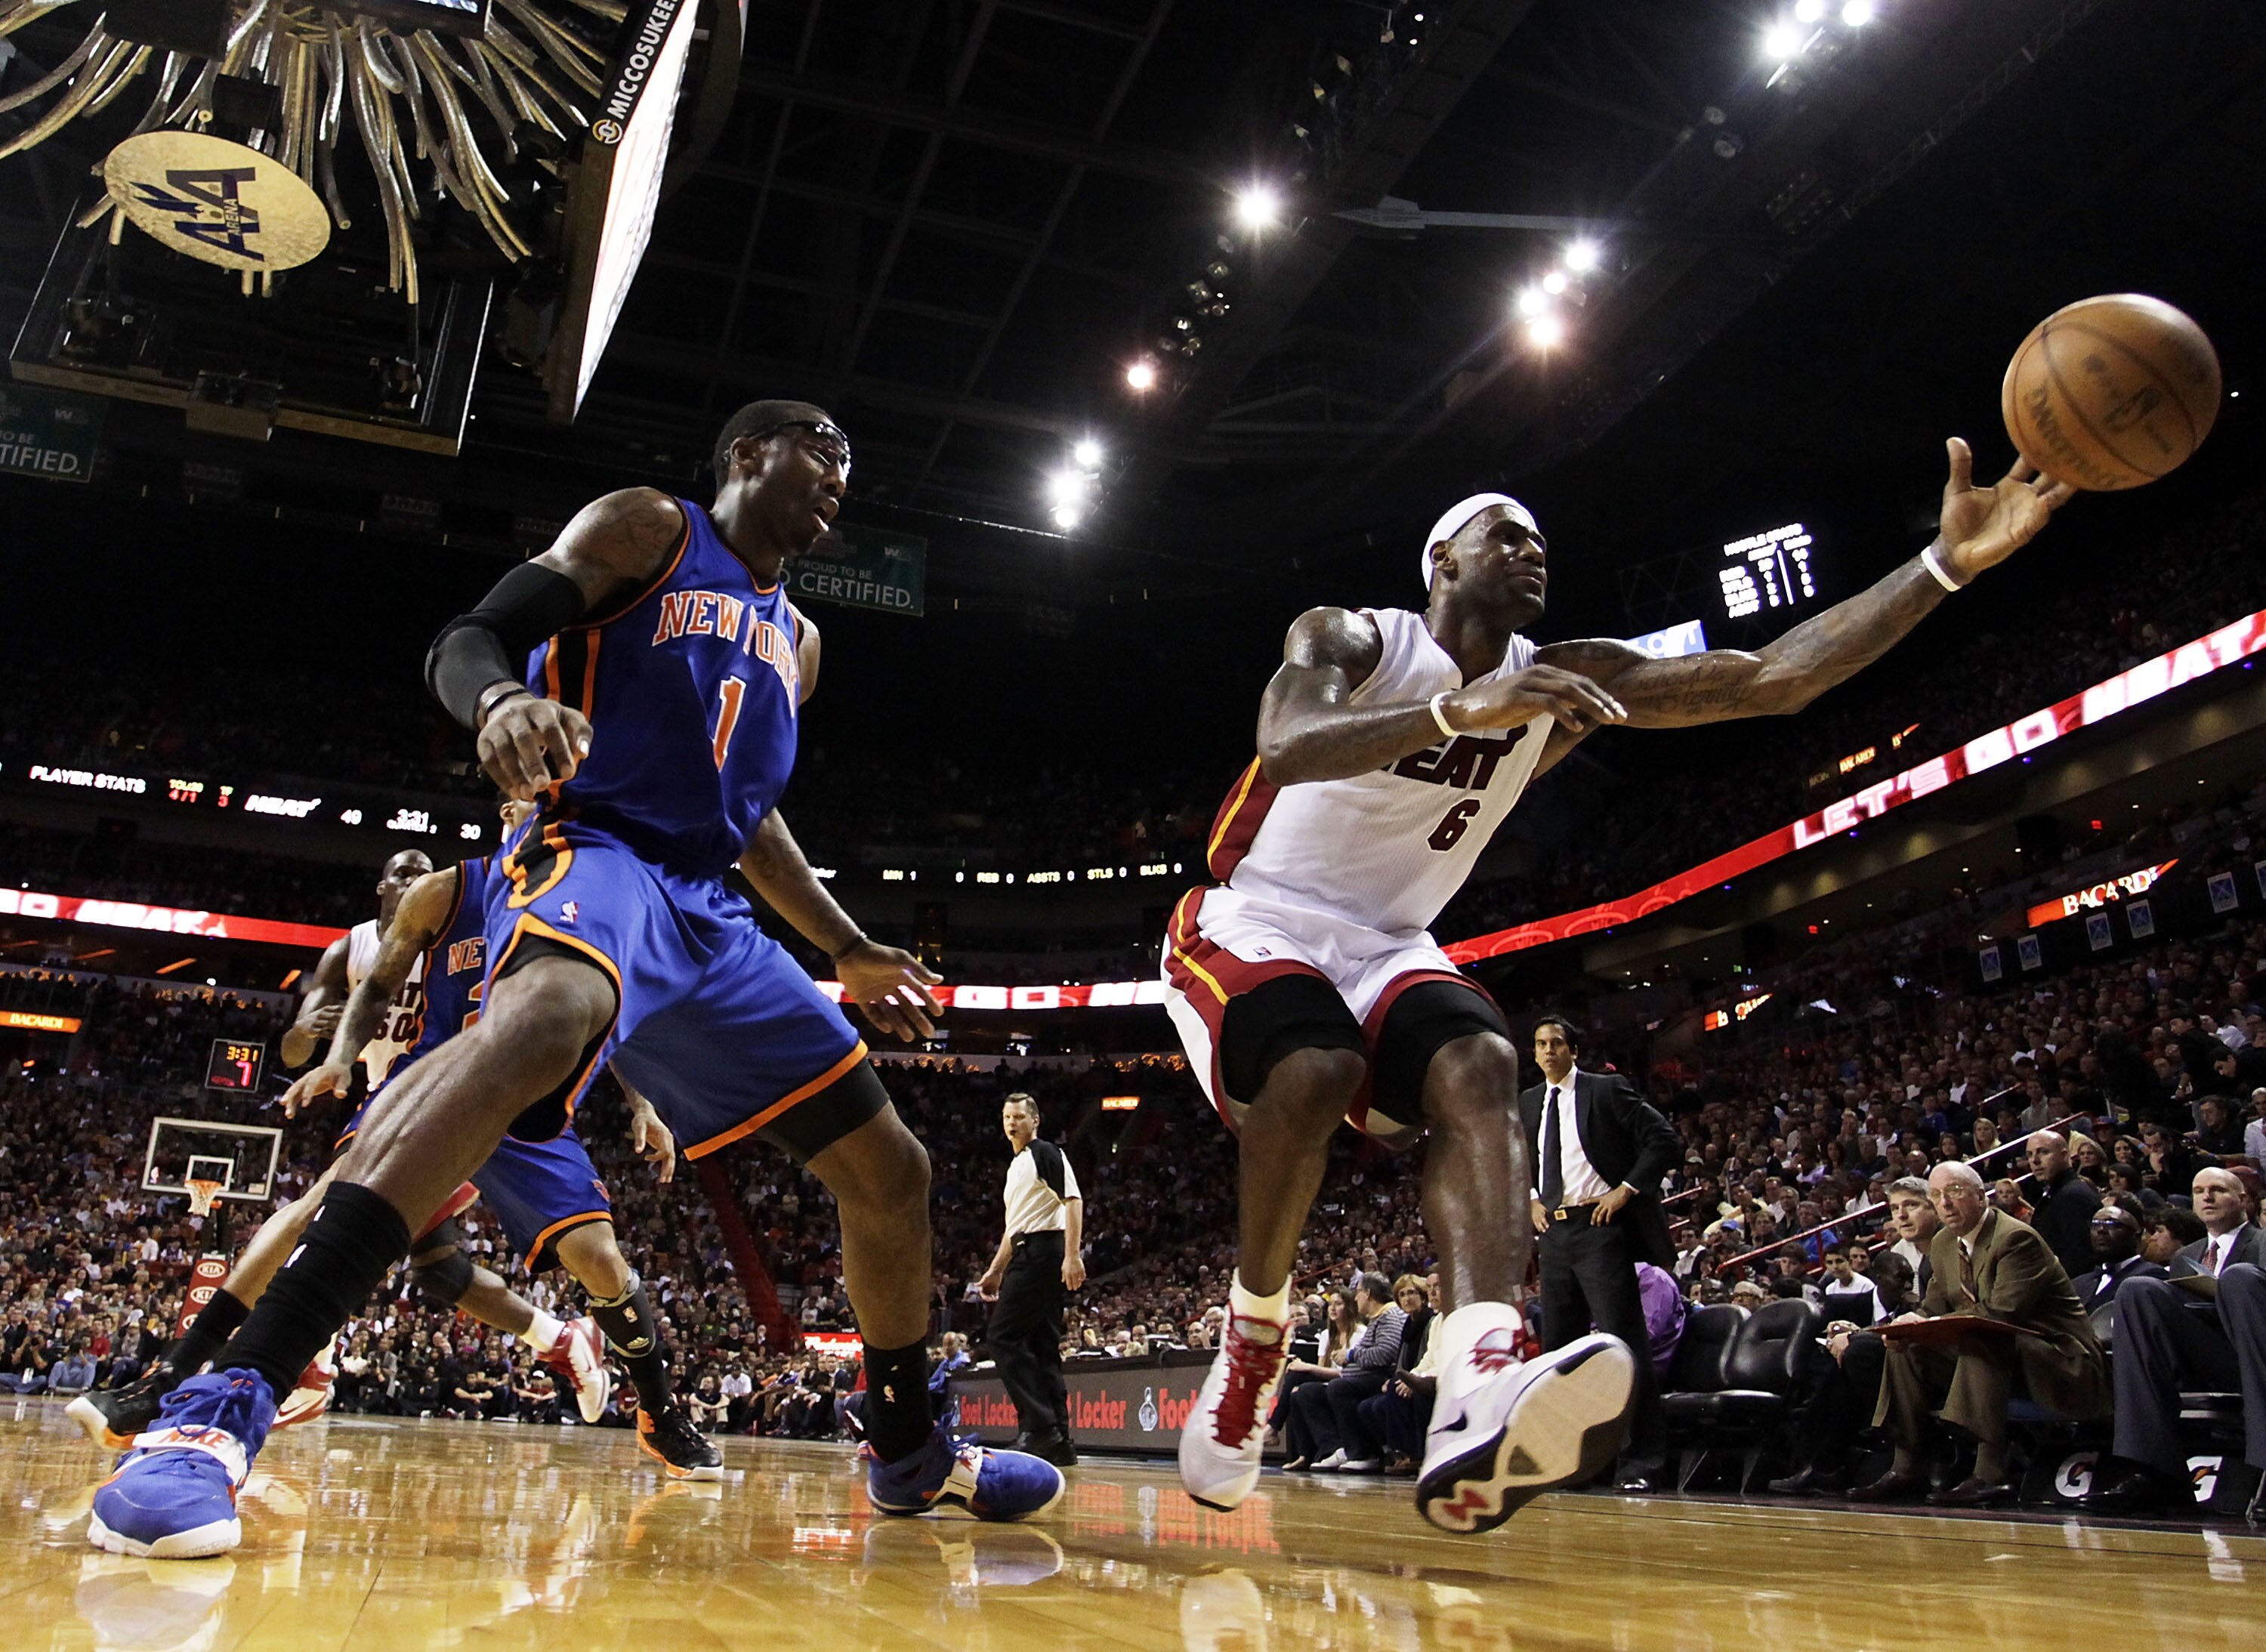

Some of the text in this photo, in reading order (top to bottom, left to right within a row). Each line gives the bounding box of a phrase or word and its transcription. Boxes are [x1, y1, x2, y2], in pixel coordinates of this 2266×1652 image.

[223, 198, 241, 236] ARENA
[798, 559, 838, 574] PROUD
[840, 565, 855, 578] TO
[859, 570, 872, 580] BE
[799, 572, 915, 609] CERTIFIED.
[652, 591, 743, 647] NEW
[712, 675, 746, 773] 1
[1794, 613, 2253, 849] LET'S GO HEAT
[1381, 723, 1528, 790] EAT
[30, 765, 146, 793] PLAYER STATS
[218, 795, 229, 807] 3
[460, 823, 481, 840] 30
[1427, 798, 1481, 852] 6
[882, 863, 1182, 884] MIN 1 0 REB 0 ASSTS 0 STLS 0 BLKS 0
[2063, 866, 2158, 916] BACARDI
[448, 937, 486, 976] NE
[10, 1013, 63, 1029] BACARDI
[227, 1045, 259, 1062] 3:31
[236, 1061, 252, 1086] 7
[200, 1265, 220, 1274] KIA
[984, 1394, 1018, 1427] Locke
[1076, 1389, 1127, 1429] Locker
[157, 1426, 229, 1449] NIKE
[2055, 1451, 2100, 1498] G
